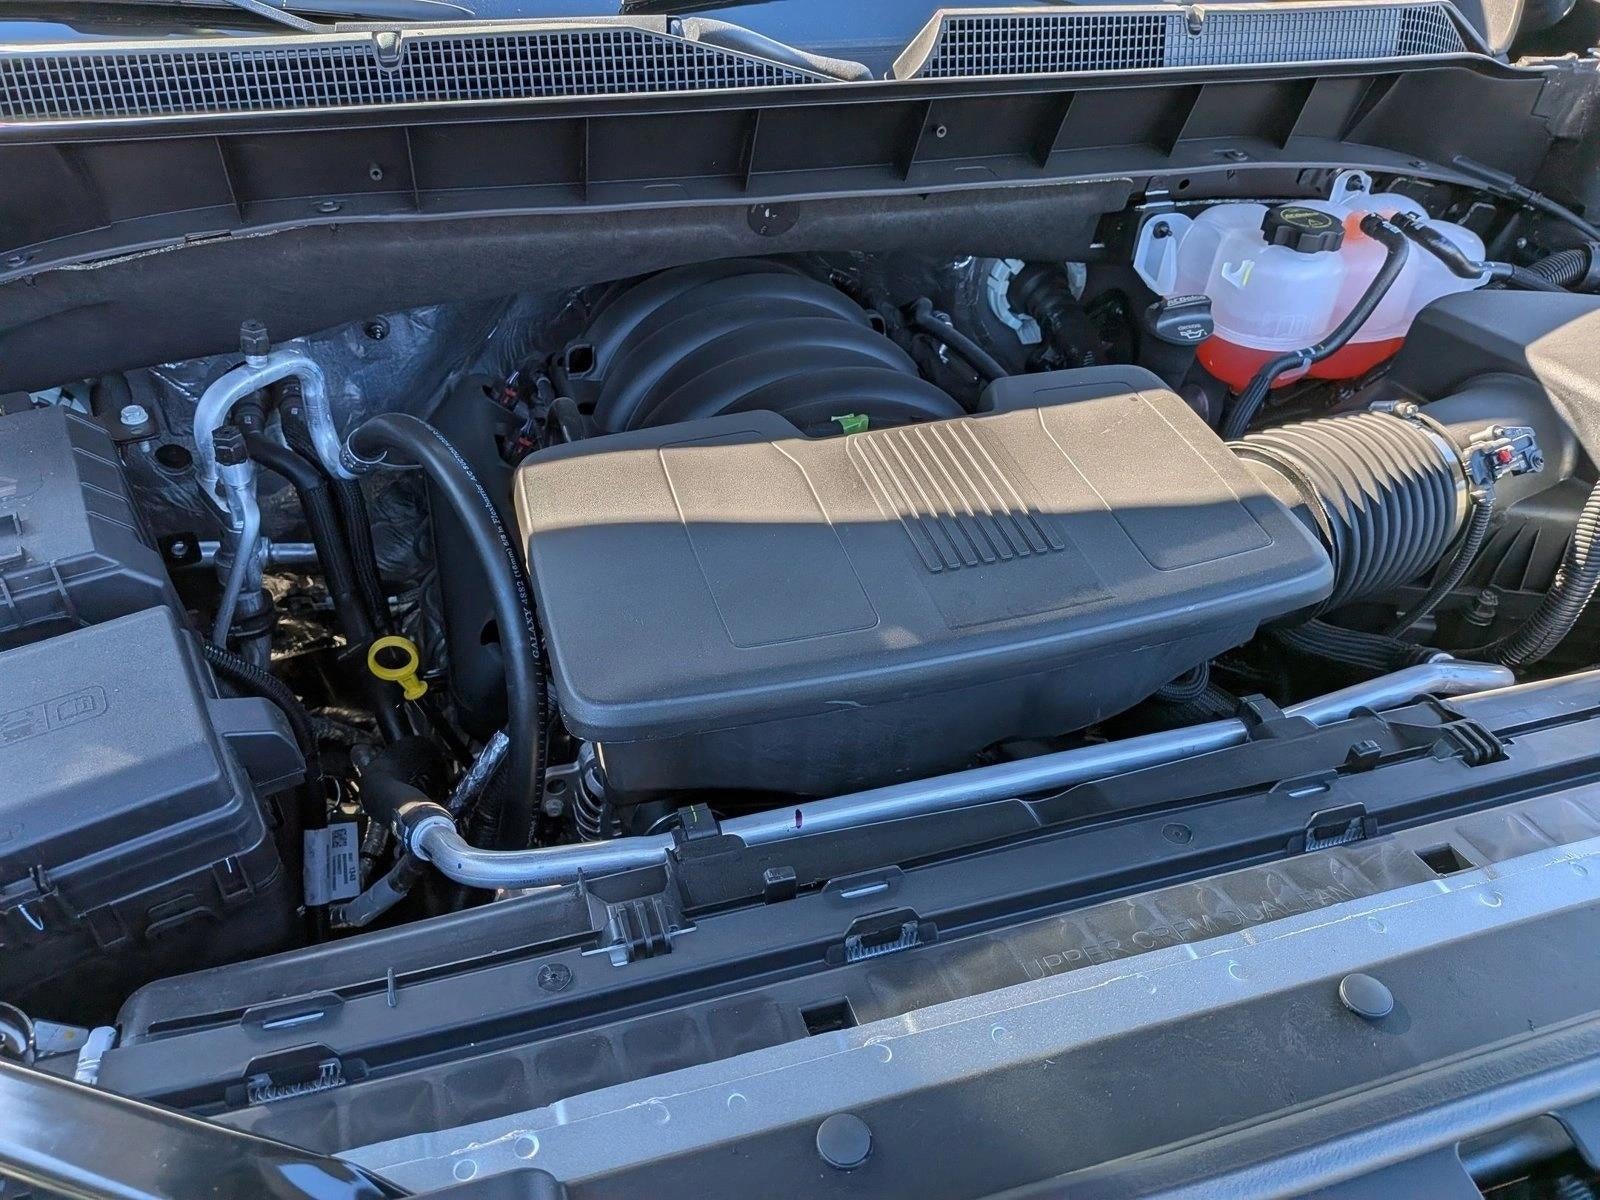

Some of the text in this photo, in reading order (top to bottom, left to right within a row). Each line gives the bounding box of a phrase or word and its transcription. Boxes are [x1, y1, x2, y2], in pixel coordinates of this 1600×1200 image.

[1167, 295, 1207, 307] ACDelco
[475, 483, 501, 525] Flexbarrier
[499, 534, 510, 547] 5/8
[505, 547, 522, 578] (16mm)
[516, 580, 529, 605] 4882
[522, 606, 540, 659] GALAXY
[1021, 938, 1125, 981] UPPER
